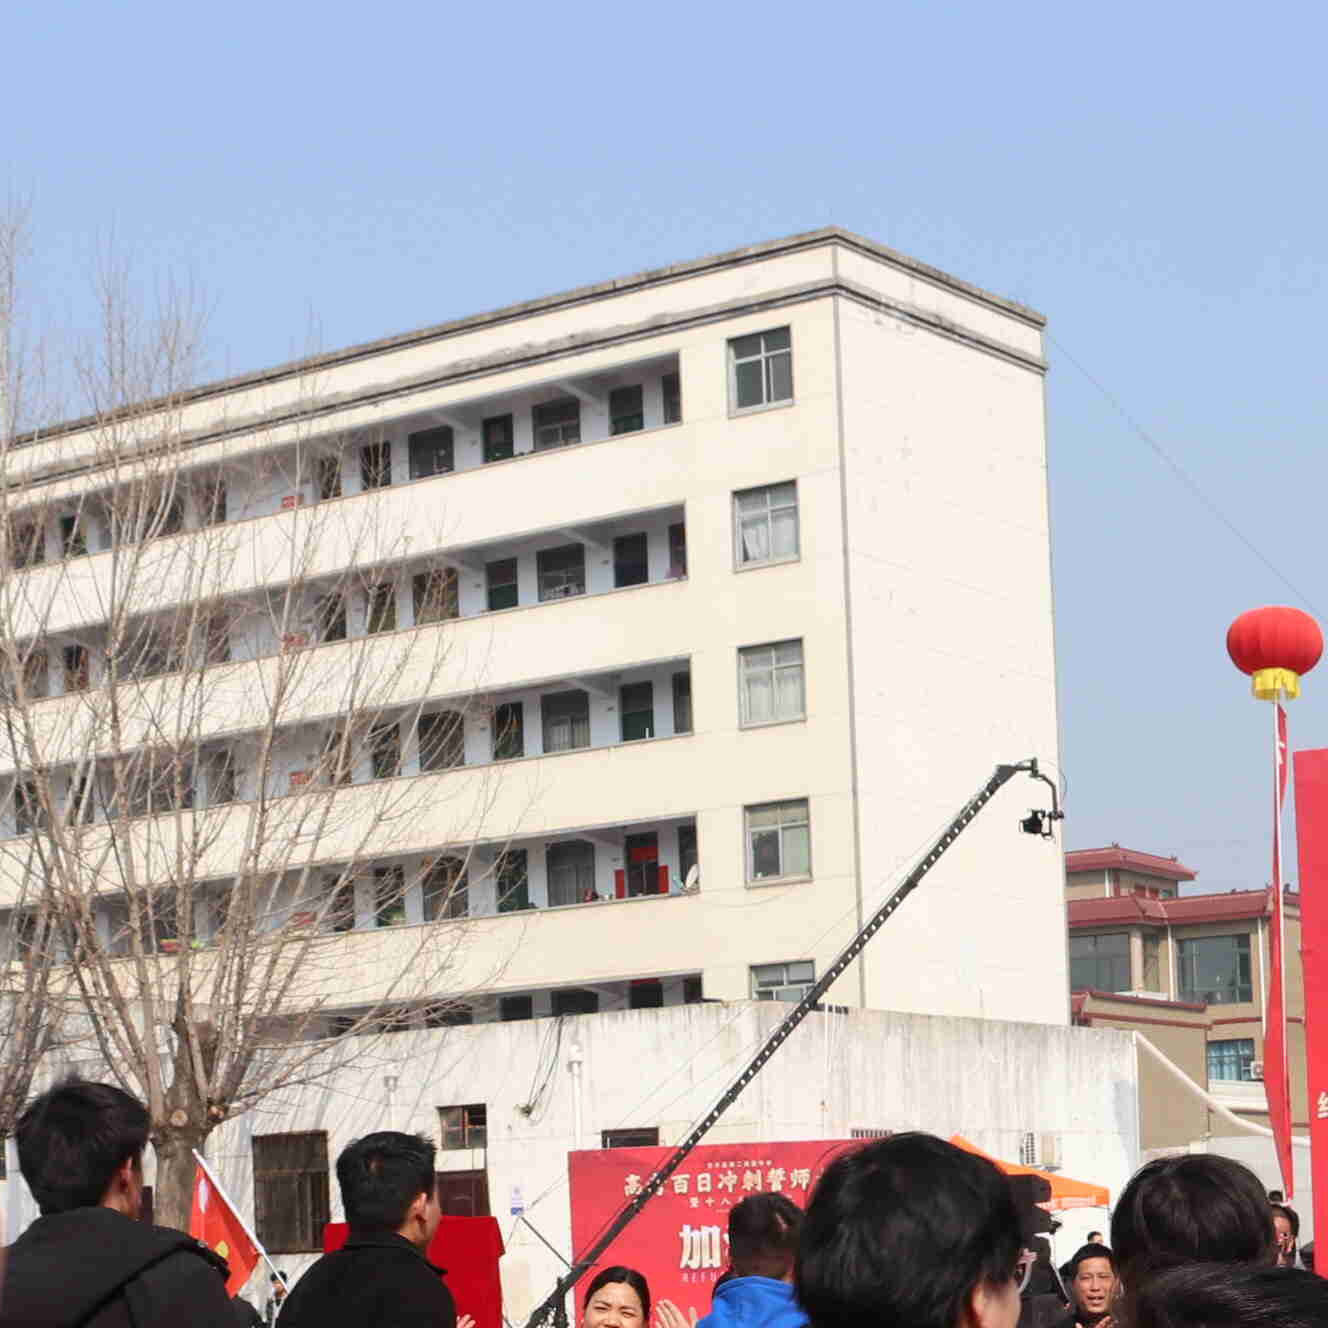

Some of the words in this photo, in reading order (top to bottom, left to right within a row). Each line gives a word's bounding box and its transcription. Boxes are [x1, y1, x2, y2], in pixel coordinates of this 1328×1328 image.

[624, 1167, 823, 1197] 高百日冲刺誓师
[679, 1224, 731, 1270] 加
